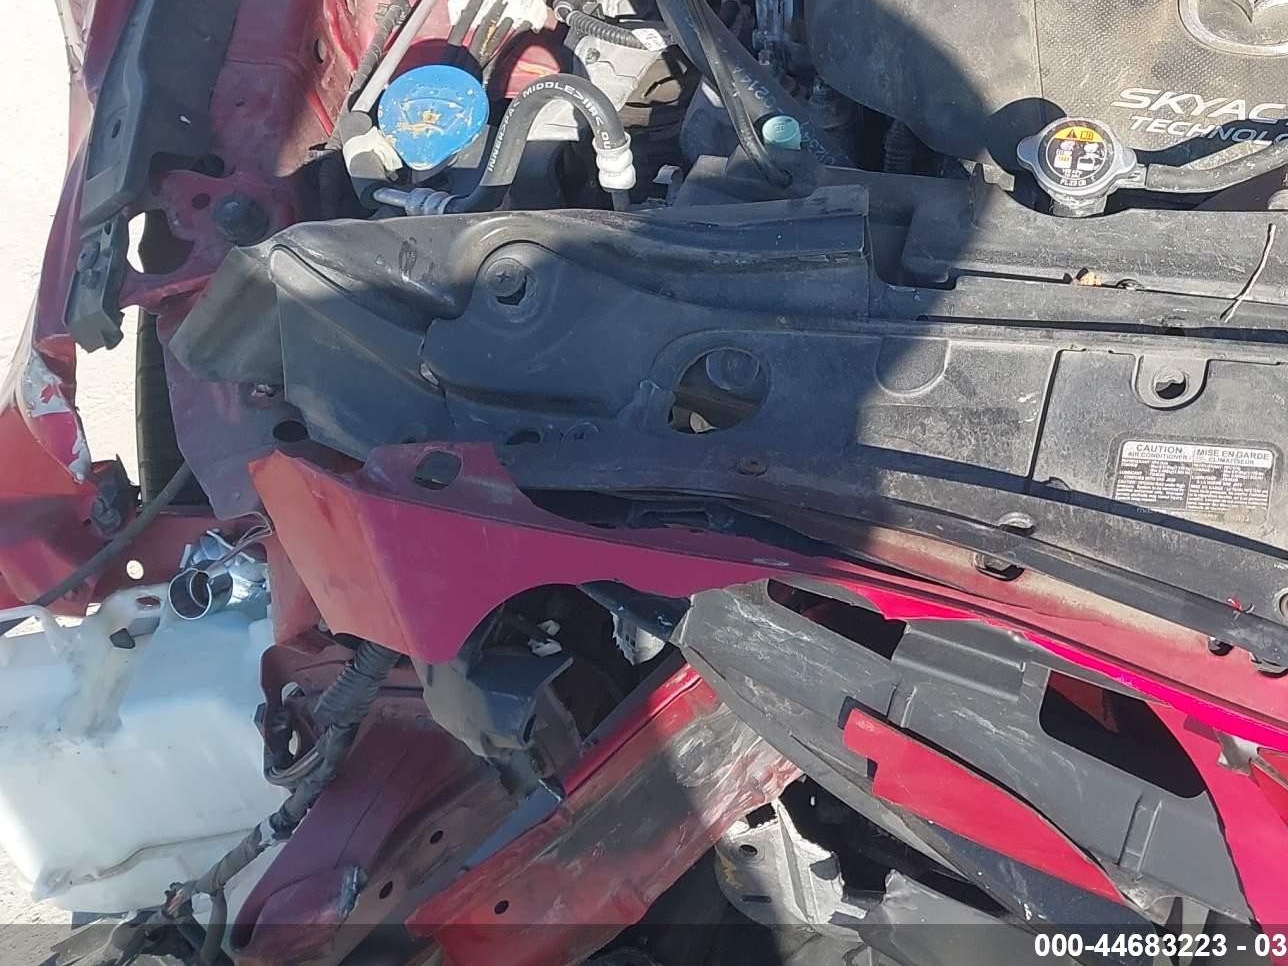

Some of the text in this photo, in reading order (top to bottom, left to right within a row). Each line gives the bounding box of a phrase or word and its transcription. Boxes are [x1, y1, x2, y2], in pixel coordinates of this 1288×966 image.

[1136, 444, 1183, 454] CAUTION
[1140, 452, 1188, 461] CONDITIONER
[1221, 450, 1235, 459] EN
[1237, 452, 1270, 461] GARDE
[1208, 456, 1255, 465] CLIMATISEUR
